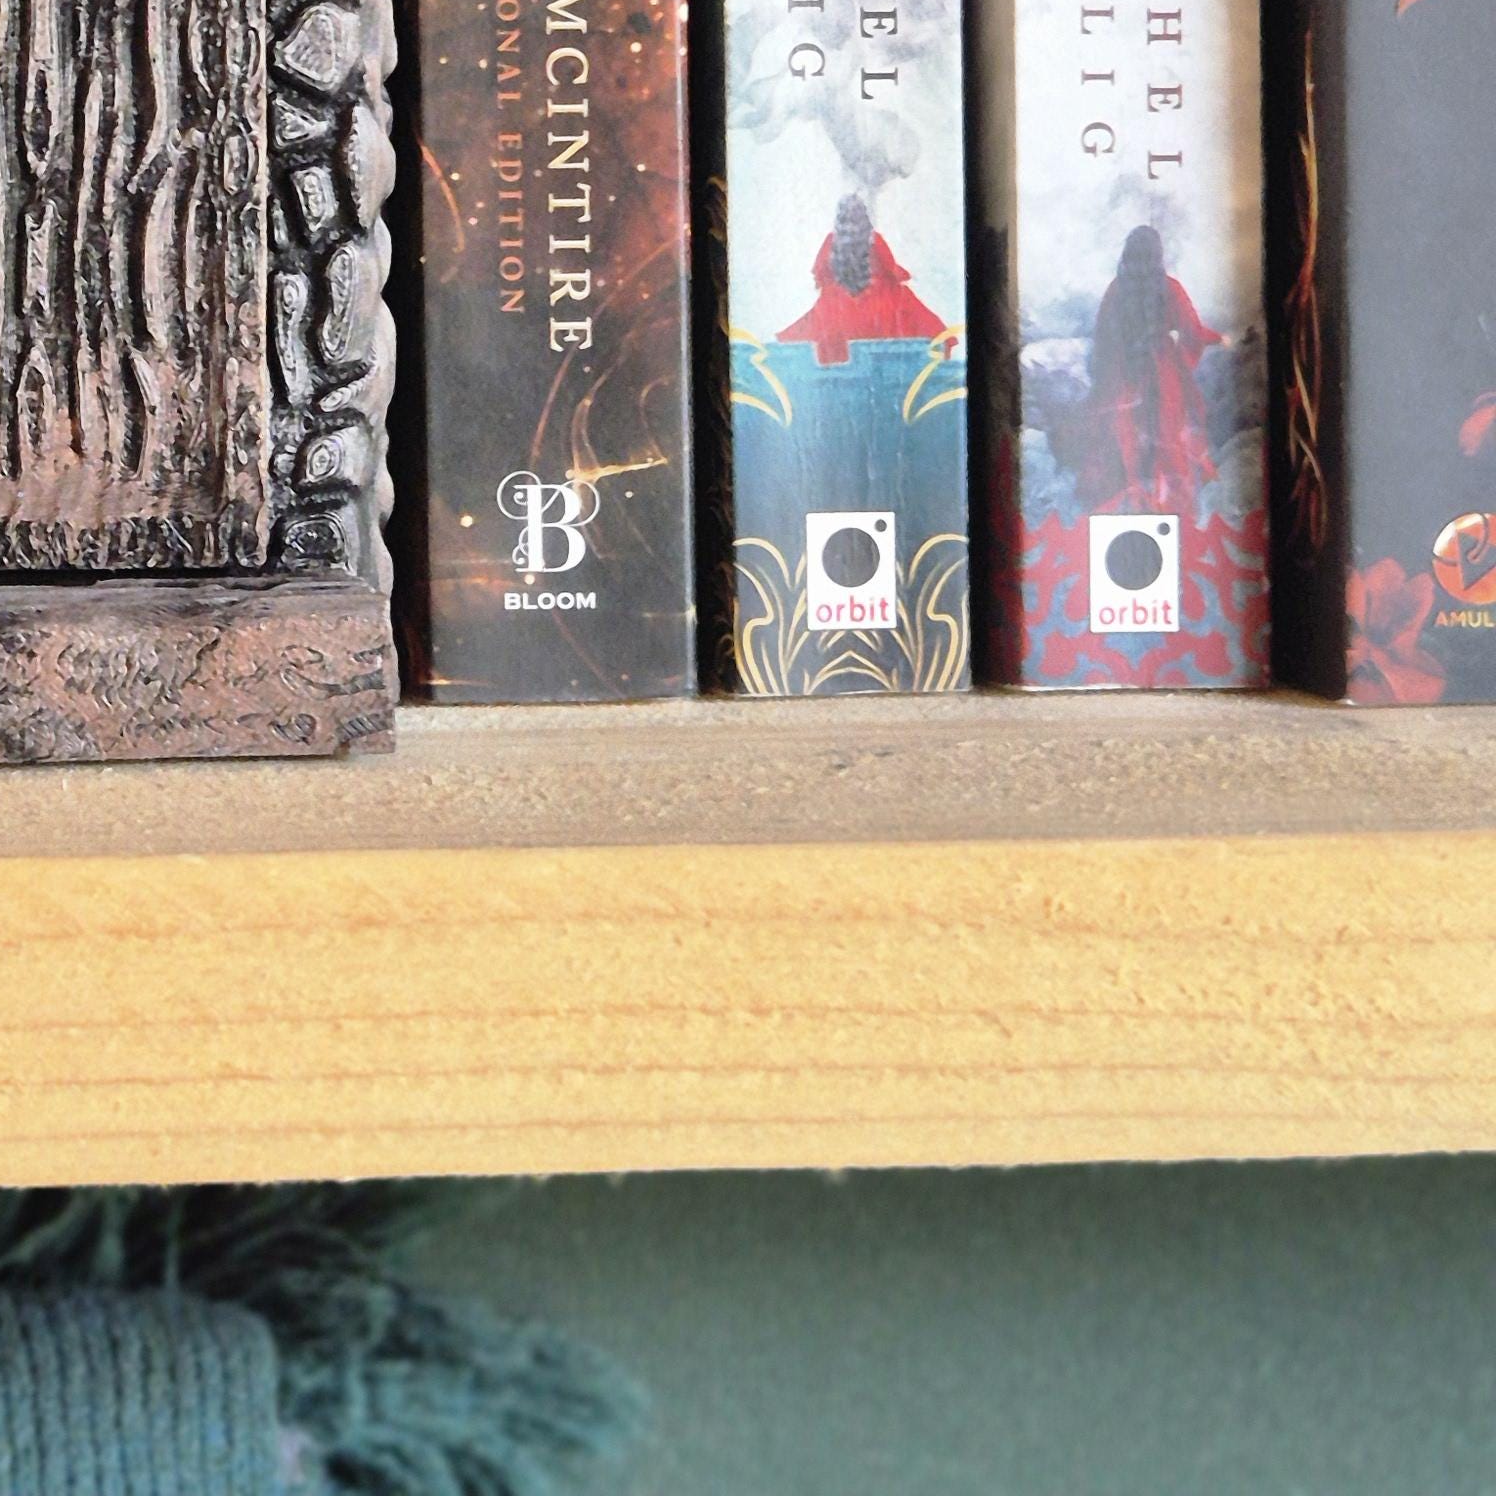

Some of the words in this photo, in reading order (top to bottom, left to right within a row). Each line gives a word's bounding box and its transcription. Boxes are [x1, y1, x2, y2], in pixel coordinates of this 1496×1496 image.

[497, 133, 525, 315] EDITION
[496, 470, 601, 572] B
[504, 592, 596, 610] BLOOM
[816, 595, 890, 623] orbit
[1098, 598, 1173, 626] orbit
